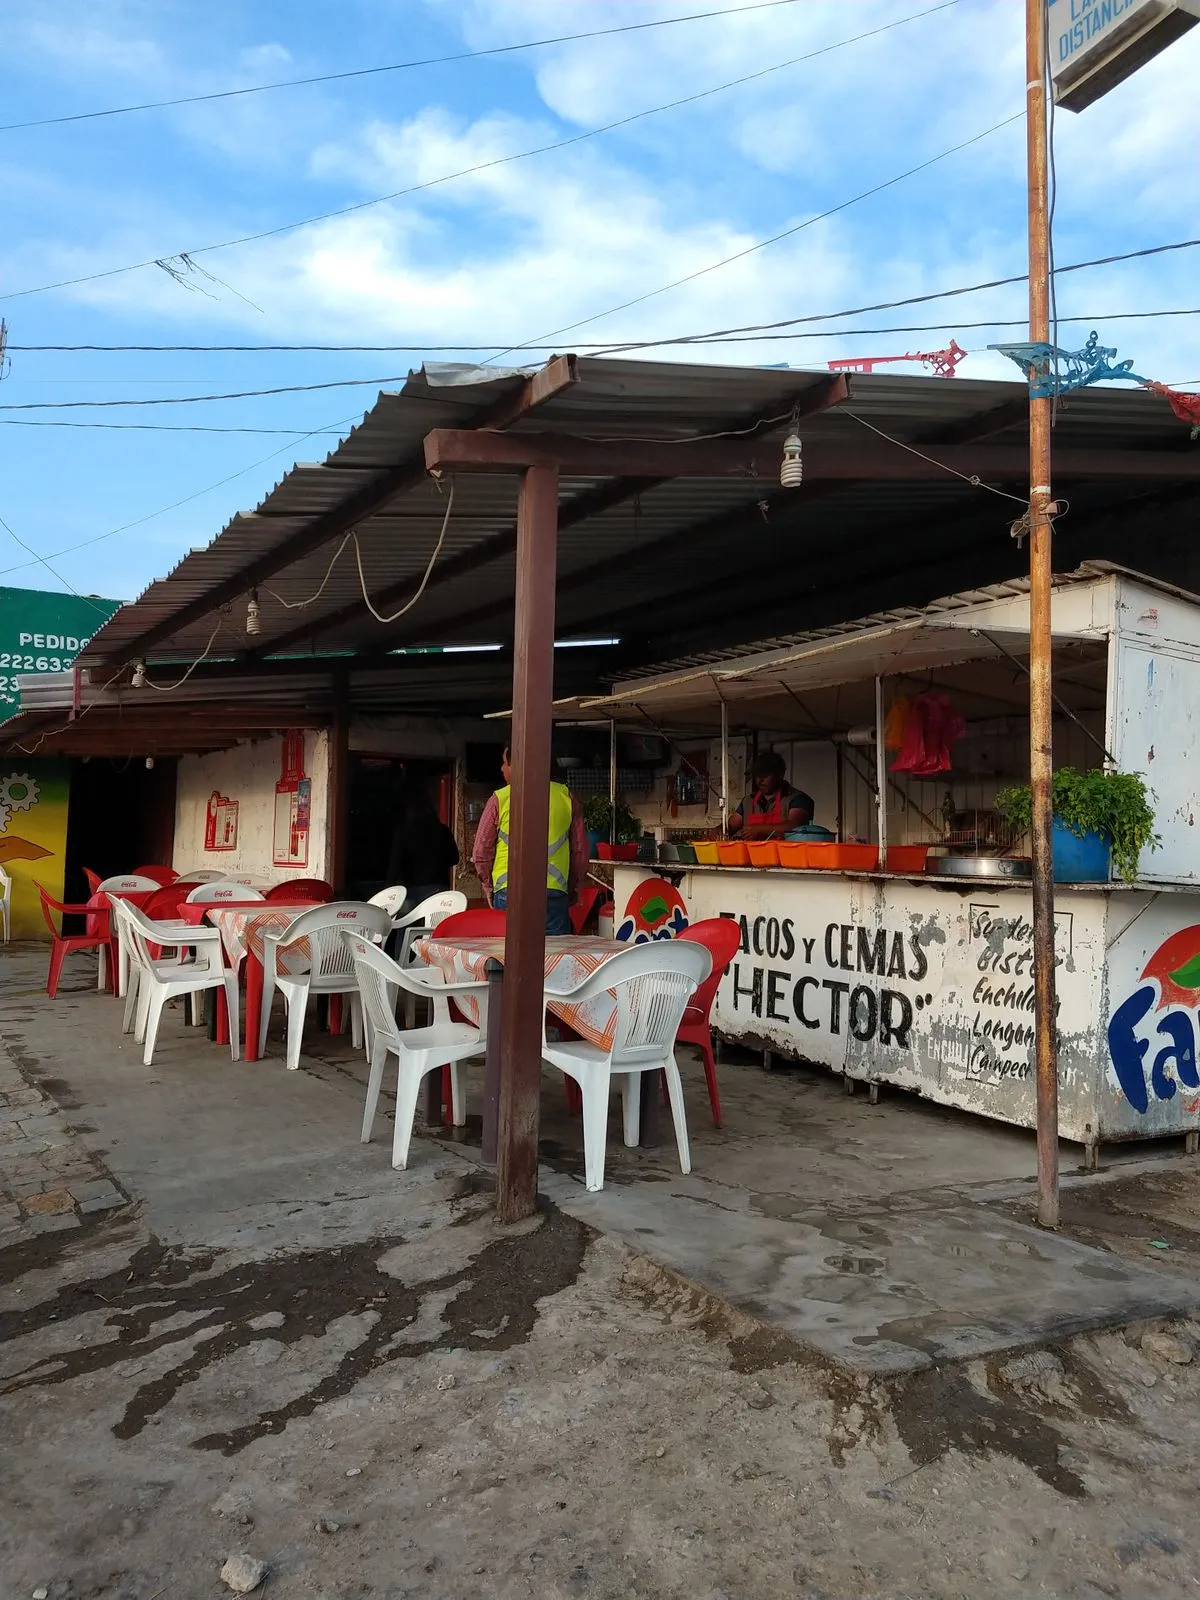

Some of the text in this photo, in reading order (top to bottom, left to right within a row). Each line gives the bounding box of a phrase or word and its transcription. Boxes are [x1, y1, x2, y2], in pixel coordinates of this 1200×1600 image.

[1059, 0, 1133, 62] DISTANC
[719, 911, 795, 961] ACOS
[802, 937, 816, 964] Y
[824, 922, 928, 982] CEMAS
[972, 976, 1061, 1018] Enchila
[972, 1010, 1061, 1052] Longan
[1107, 985, 1200, 1114] Fa
